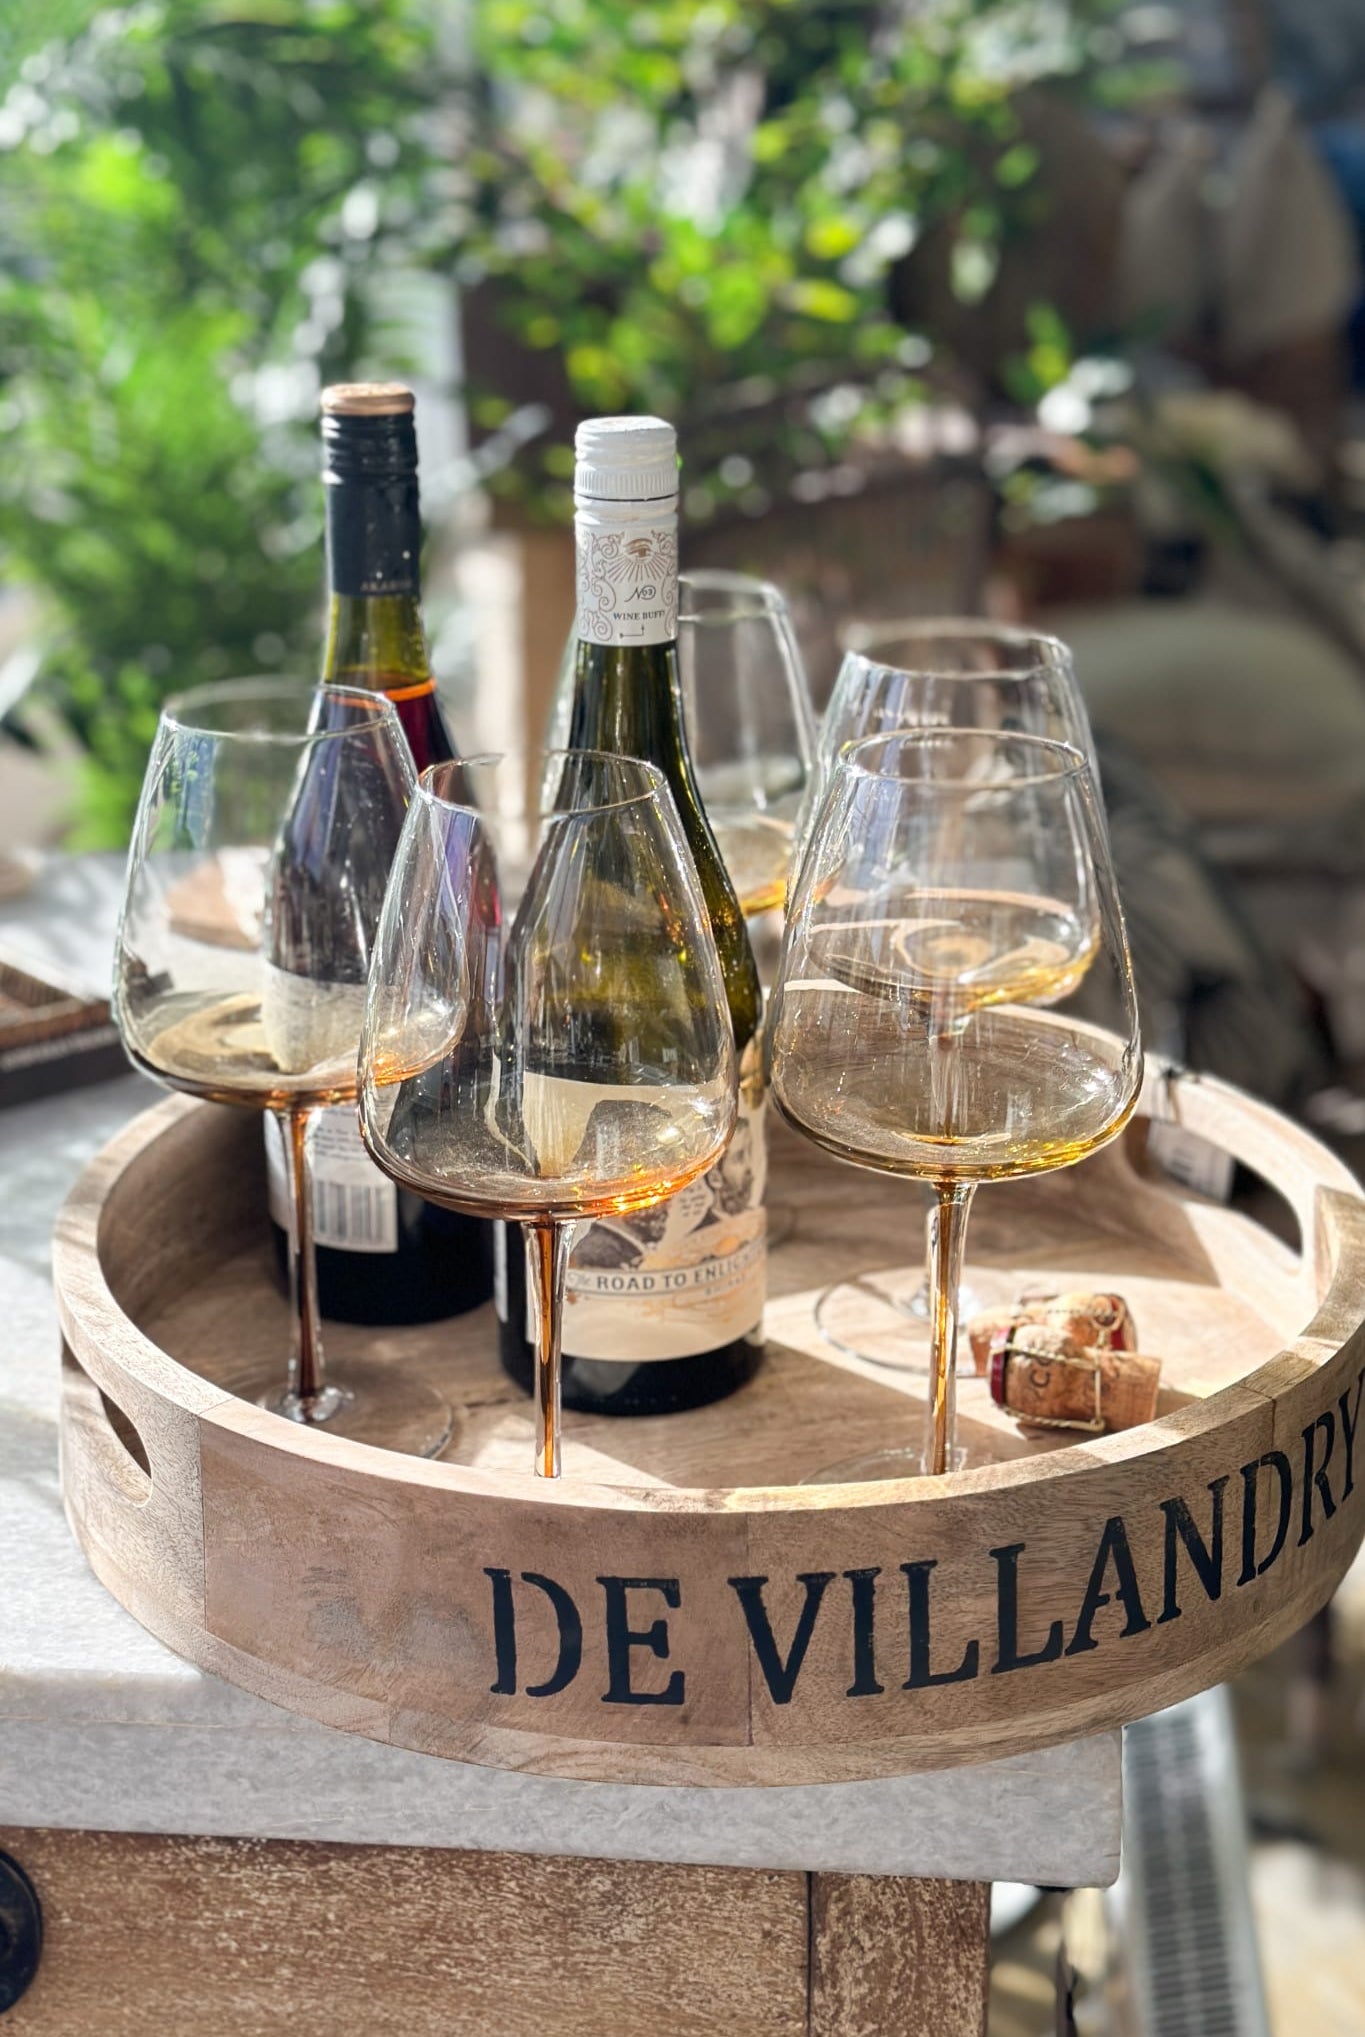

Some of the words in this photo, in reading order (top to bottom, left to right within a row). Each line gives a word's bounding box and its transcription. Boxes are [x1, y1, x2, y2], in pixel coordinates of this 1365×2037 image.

[613, 612, 641, 621] WINE
[642, 610, 666, 620] BUFF
[596, 1275, 656, 1292] ROAD
[663, 1273, 688, 1290] TO
[483, 1567, 685, 1705] DE
[727, 1368, 1365, 1705] VILLANDRY
